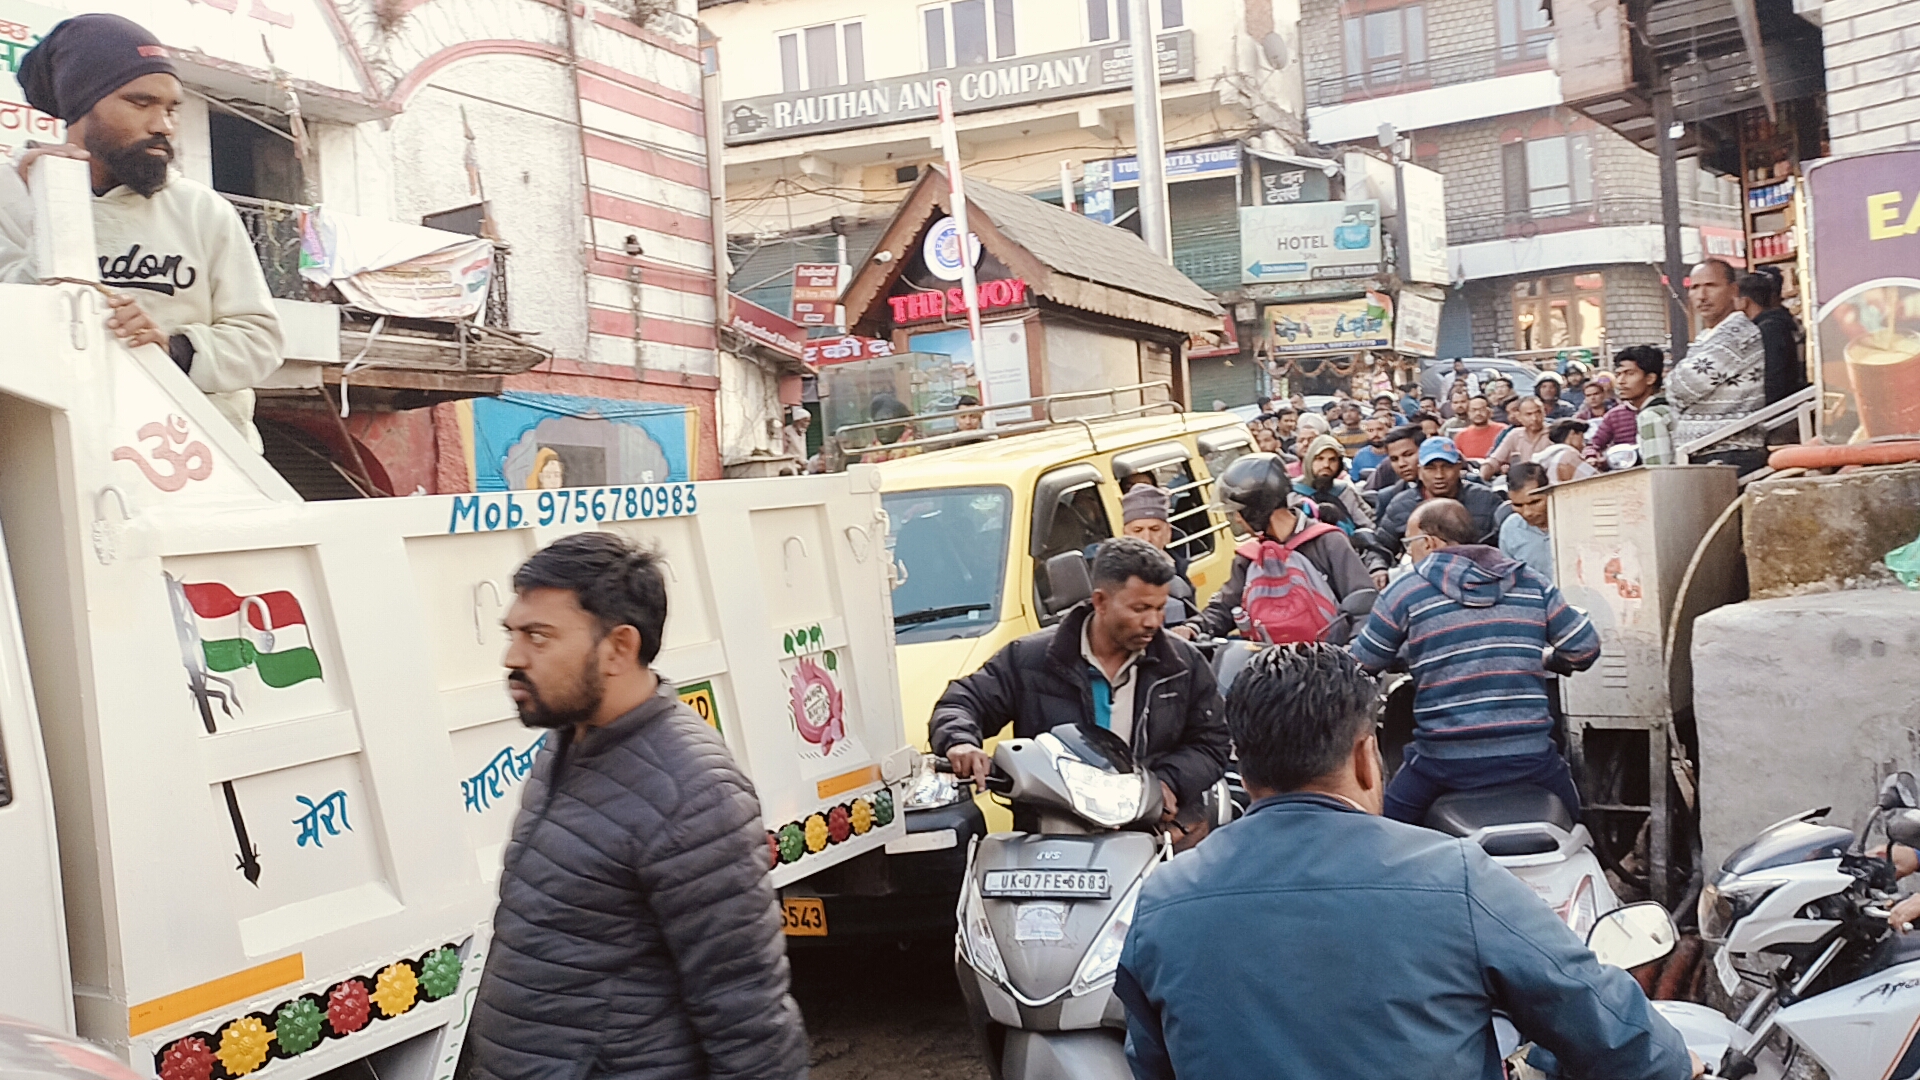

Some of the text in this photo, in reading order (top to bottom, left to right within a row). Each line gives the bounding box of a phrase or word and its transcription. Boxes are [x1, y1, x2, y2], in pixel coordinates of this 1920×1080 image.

[773, 87, 890, 129] RAUTHAN
[959, 55, 1091, 101] COMPANY
[1195, 149, 1238, 163] STORE
[1277, 234, 1329, 251] HOTEL
[888, 291, 944, 323] THE
[820, 337, 863, 358] की
[449, 483, 697, 534] Mob. 9756780983
[292, 789, 354, 848] मेरा
